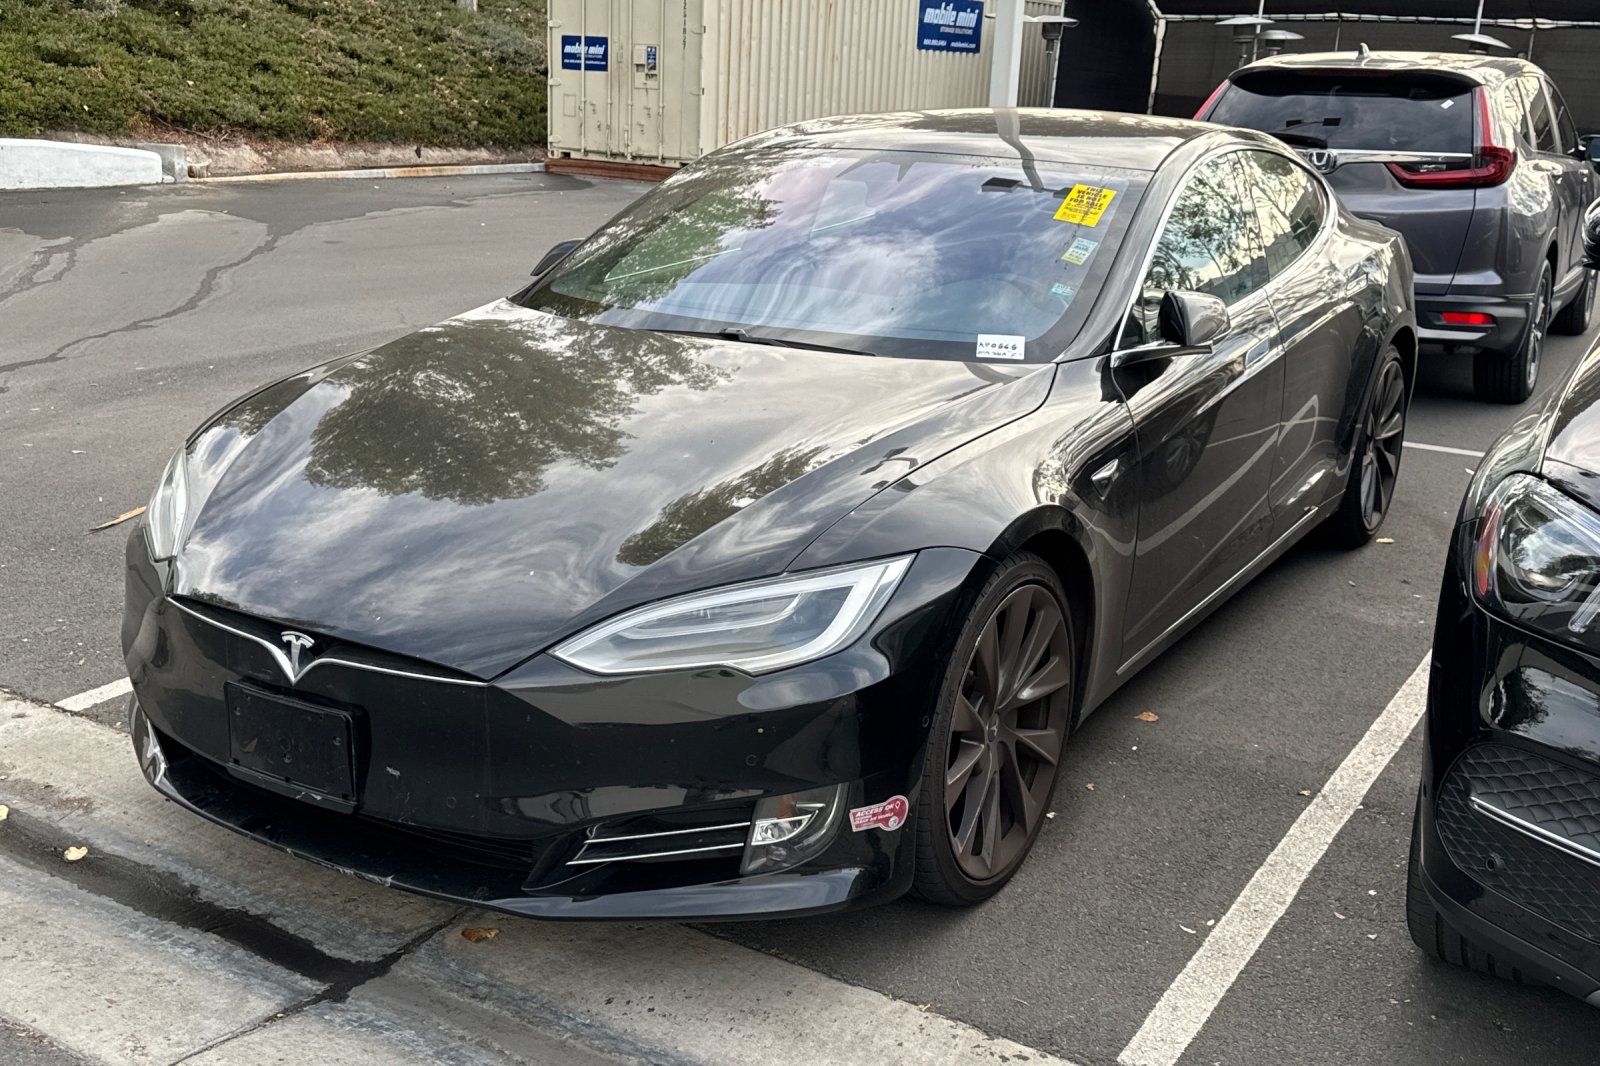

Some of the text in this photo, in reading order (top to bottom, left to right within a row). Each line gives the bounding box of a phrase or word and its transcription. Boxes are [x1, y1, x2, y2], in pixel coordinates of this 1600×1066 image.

[923, 2, 979, 28] mobile mini
[586, 43, 606, 55] mini
[1077, 189, 1108, 199] VEHICLE
[1086, 195, 1101, 203] NOT
[855, 803, 895, 817] ACCESS OK
